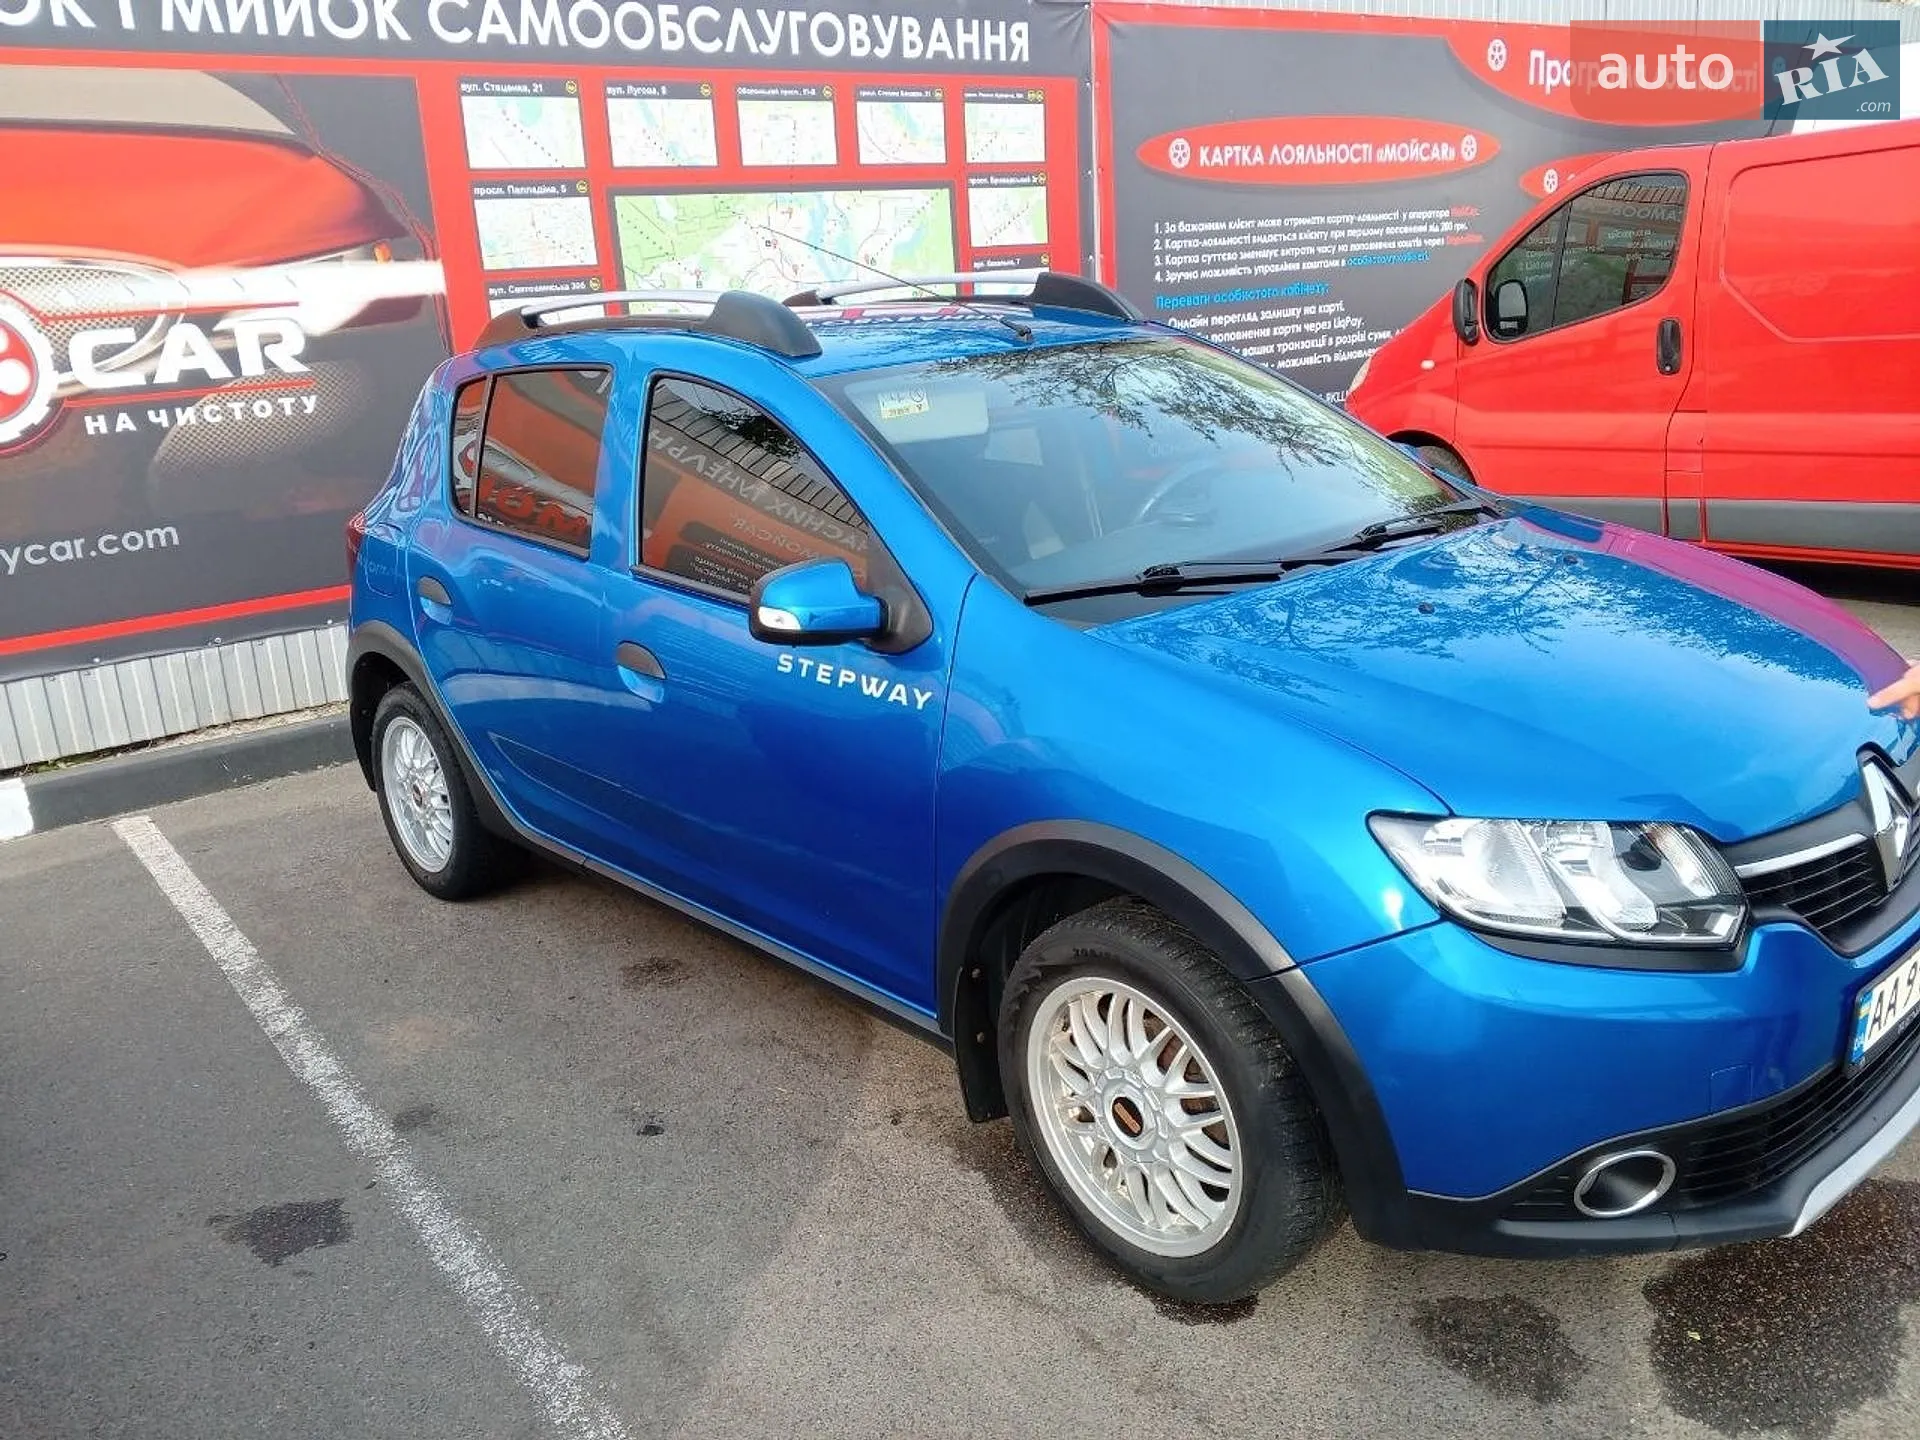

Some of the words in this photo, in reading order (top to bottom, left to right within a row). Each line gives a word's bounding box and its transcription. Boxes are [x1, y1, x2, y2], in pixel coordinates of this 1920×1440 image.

[428, 0, 1031, 62] САМООБСЛУГОВУВАННЯ
[1200, 144, 1265, 167] КАРТКА
[1268, 142, 1373, 165] ЛОЯЛЬНОСТІ
[1154, 221, 1163, 234] 1.
[68, 318, 312, 389] CAR
[85, 411, 137, 435] НА
[148, 395, 317, 428] ЧИСТОТУ
[0, 524, 180, 576] ycar.com
[777, 653, 933, 710] STEPWAY
[1867, 976, 1900, 1040] AA
[1904, 960, 1920, 1009] 9
